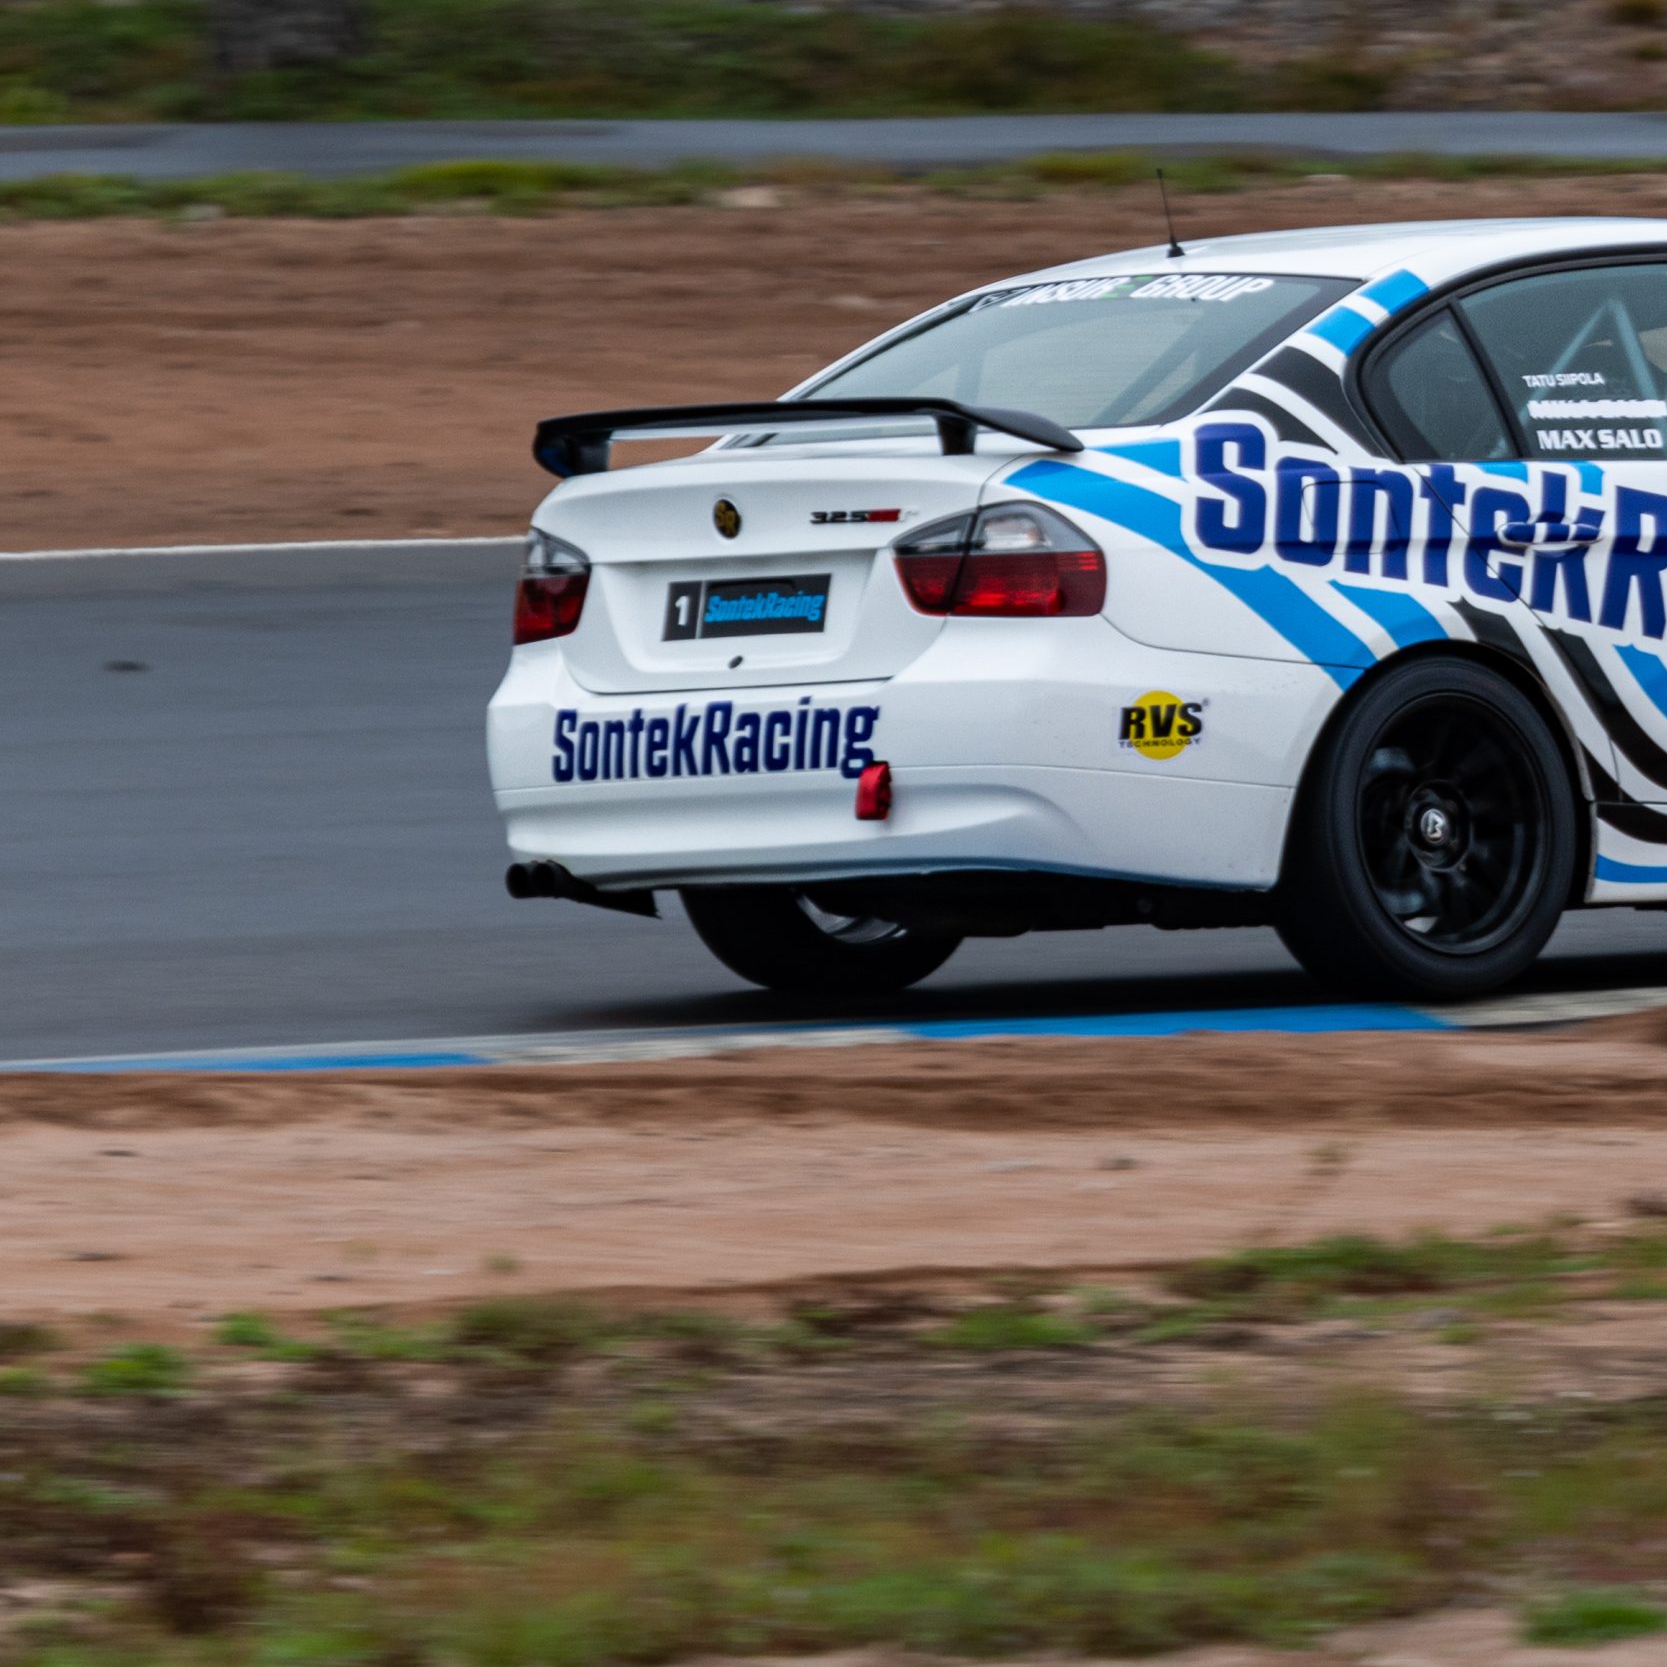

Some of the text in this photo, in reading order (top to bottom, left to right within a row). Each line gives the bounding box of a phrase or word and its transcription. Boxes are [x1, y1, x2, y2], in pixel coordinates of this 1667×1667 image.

[1130, 275, 1275, 301] GROUP
[1522, 373, 1605, 387] TATU SIIPOLA
[1536, 429, 1664, 450] MAX SALO
[675, 590, 824, 626] 1 SontekRacing
[1118, 703, 1202, 740] RVS
[553, 696, 880, 783] SontekRacing
[1118, 738, 1201, 748] TECHNOLOGY
